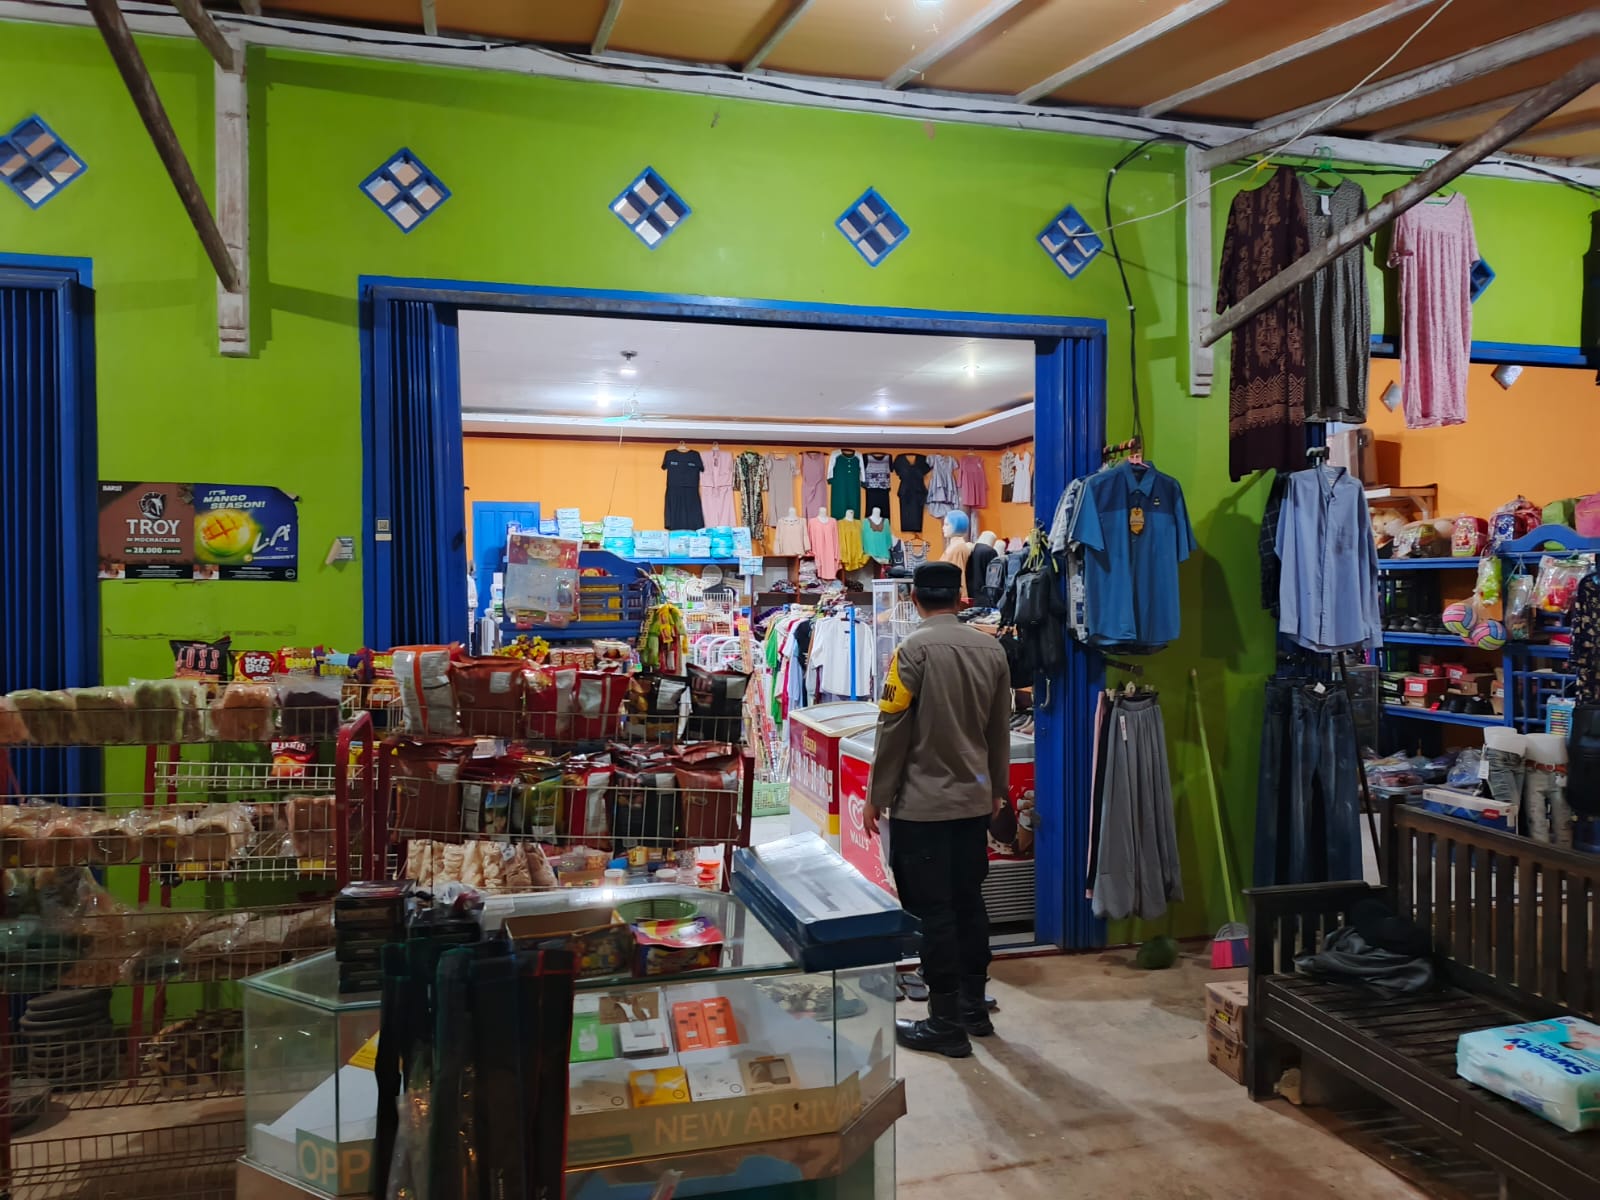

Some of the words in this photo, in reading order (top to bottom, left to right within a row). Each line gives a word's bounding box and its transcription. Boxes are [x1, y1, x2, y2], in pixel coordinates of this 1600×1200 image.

[203, 494, 247, 503] MANGO
[210, 501, 266, 509] SEASON!
[126, 519, 180, 535] TROY
[245, 664, 270, 674] Bee
[654, 1109, 736, 1146] NEW
[299, 1139, 371, 1189] OPP
